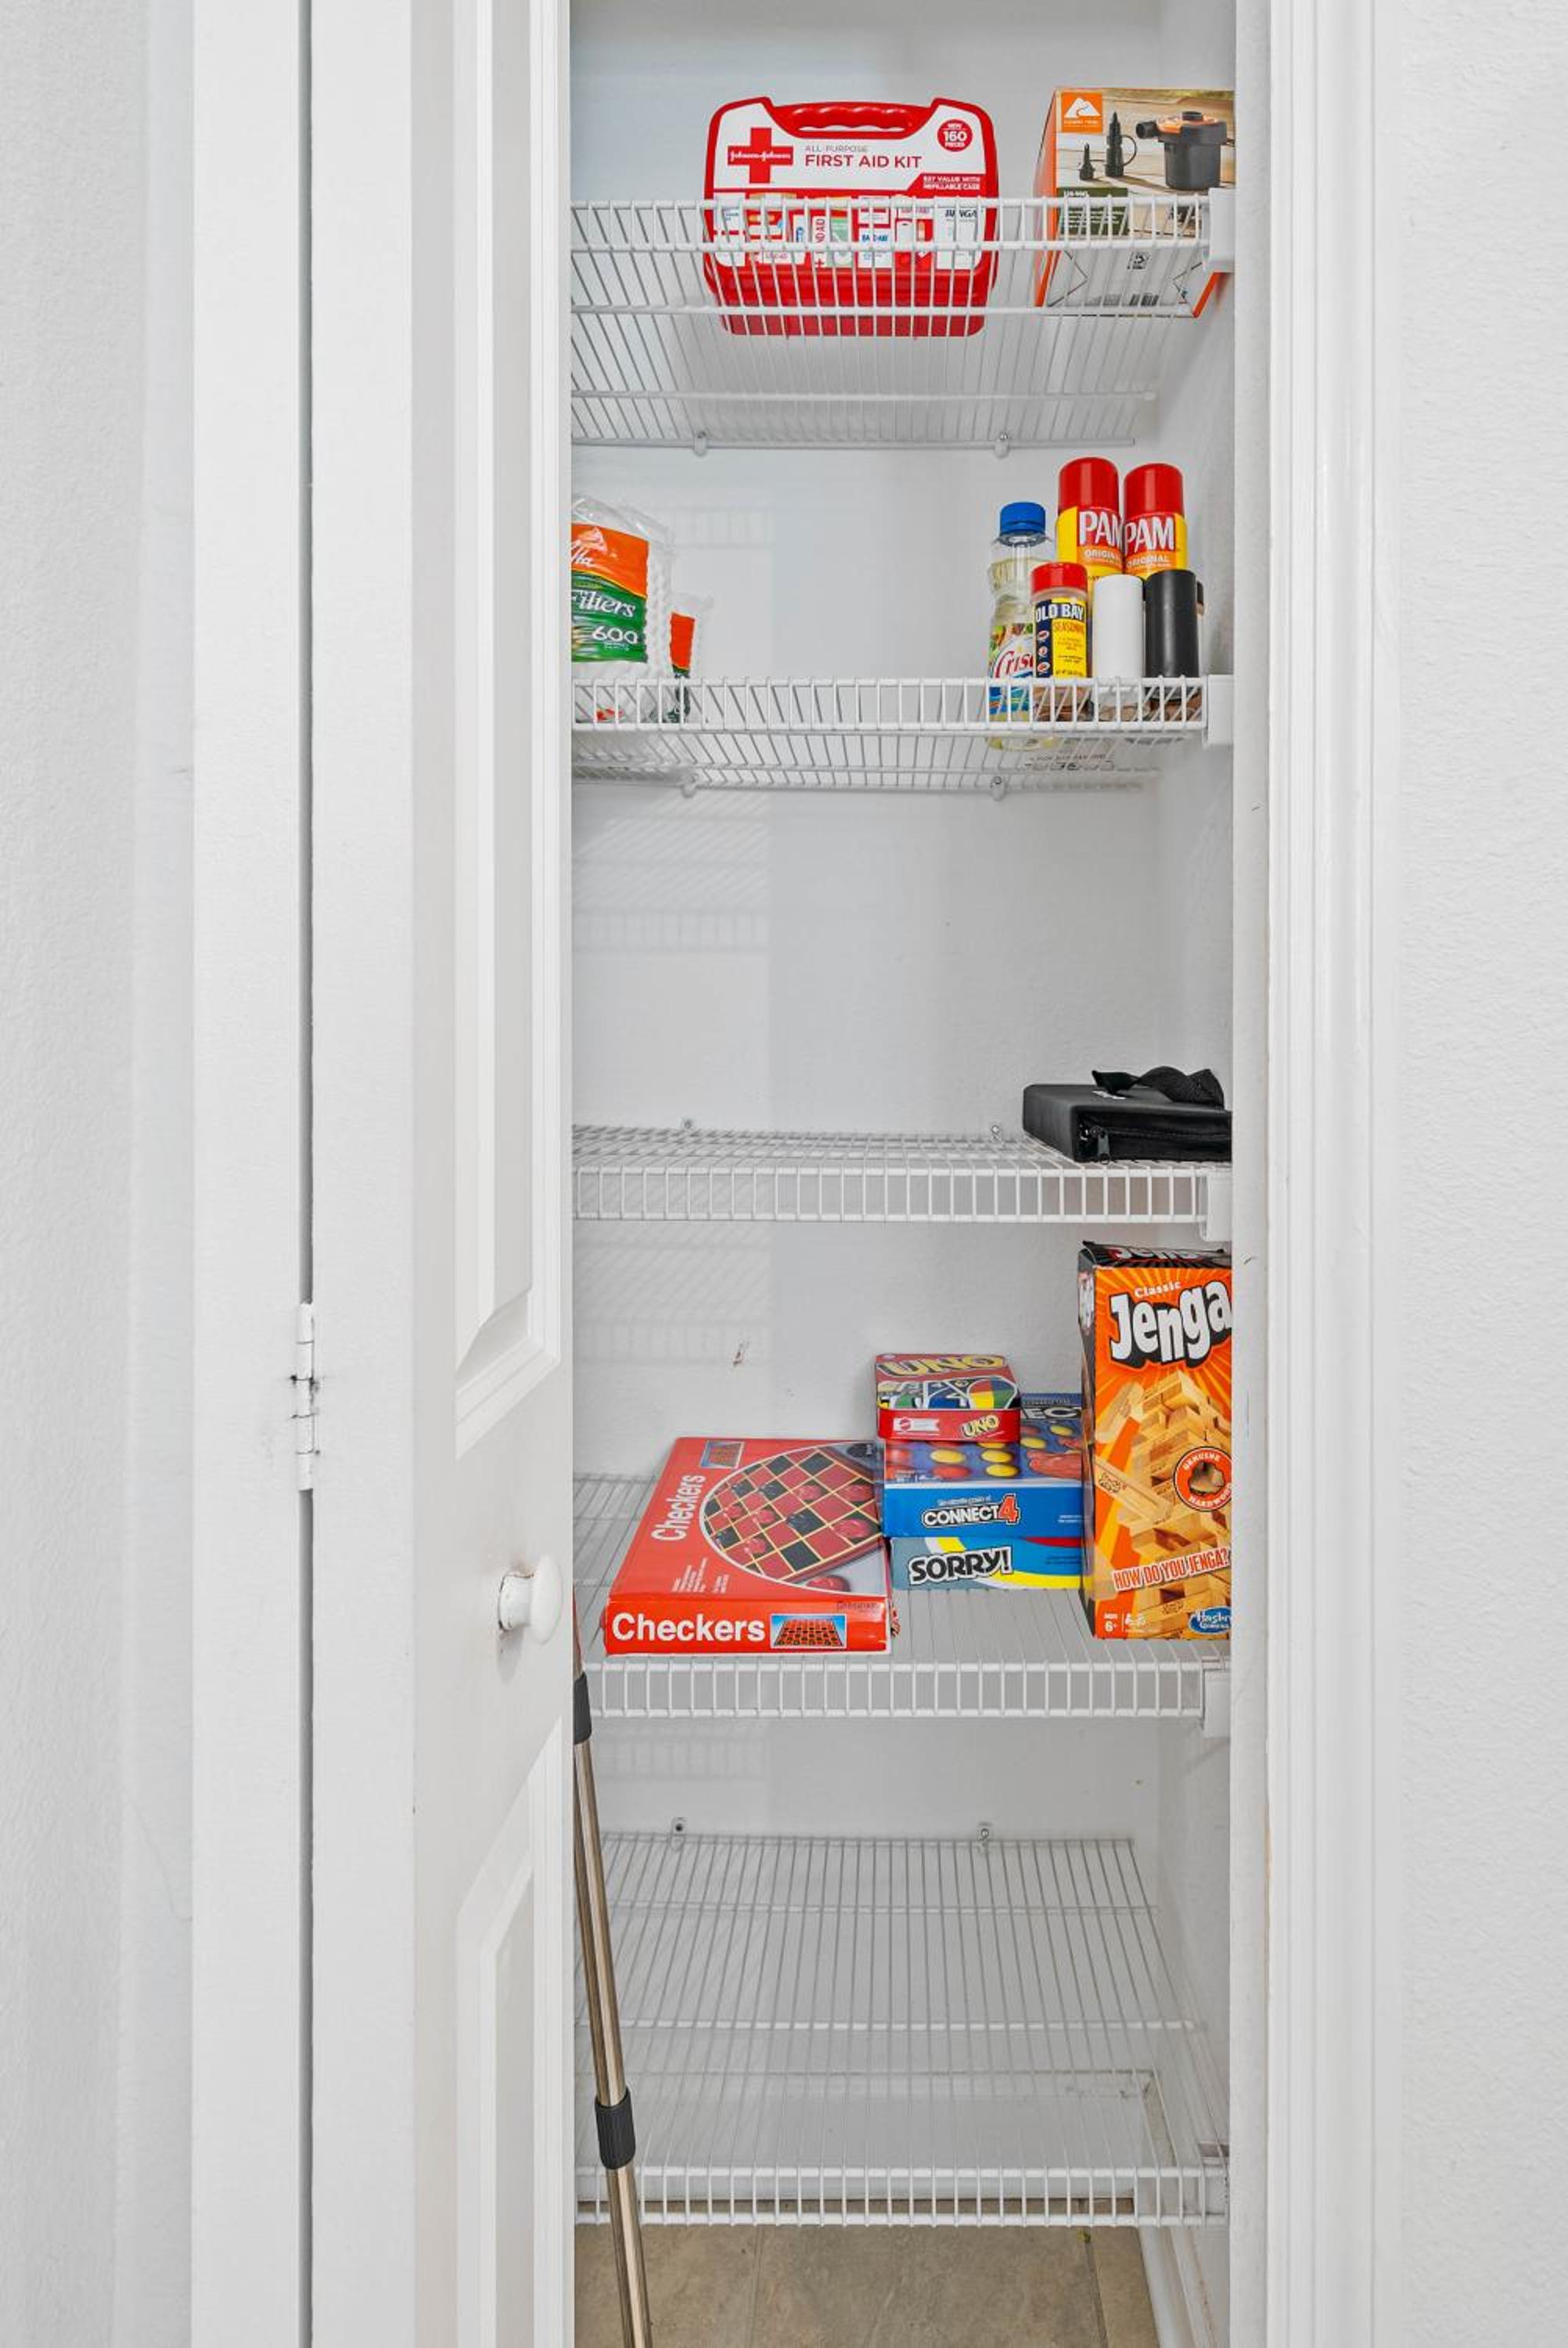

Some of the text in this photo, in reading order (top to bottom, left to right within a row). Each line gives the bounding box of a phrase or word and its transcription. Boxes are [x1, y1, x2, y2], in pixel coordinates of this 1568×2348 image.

[943, 131, 968, 142] 160
[805, 154, 922, 168] FIRST AID KIT
[1125, 516, 1174, 556] PAM
[1035, 603, 1084, 623] OLD BAY
[592, 625, 638, 644] 600
[1134, 1281, 1181, 1298] Classic
[1109, 1280, 1232, 1363] Jenga
[961, 1414, 1000, 1439] UNO
[651, 1475, 706, 1540] Checkers
[923, 1494, 1020, 1526] CONNECT 4
[910, 1549, 1010, 1583] SORRY!
[1113, 1547, 1228, 1590] HOW DO YOU JENGA?
[612, 1612, 766, 1641] Checkers
